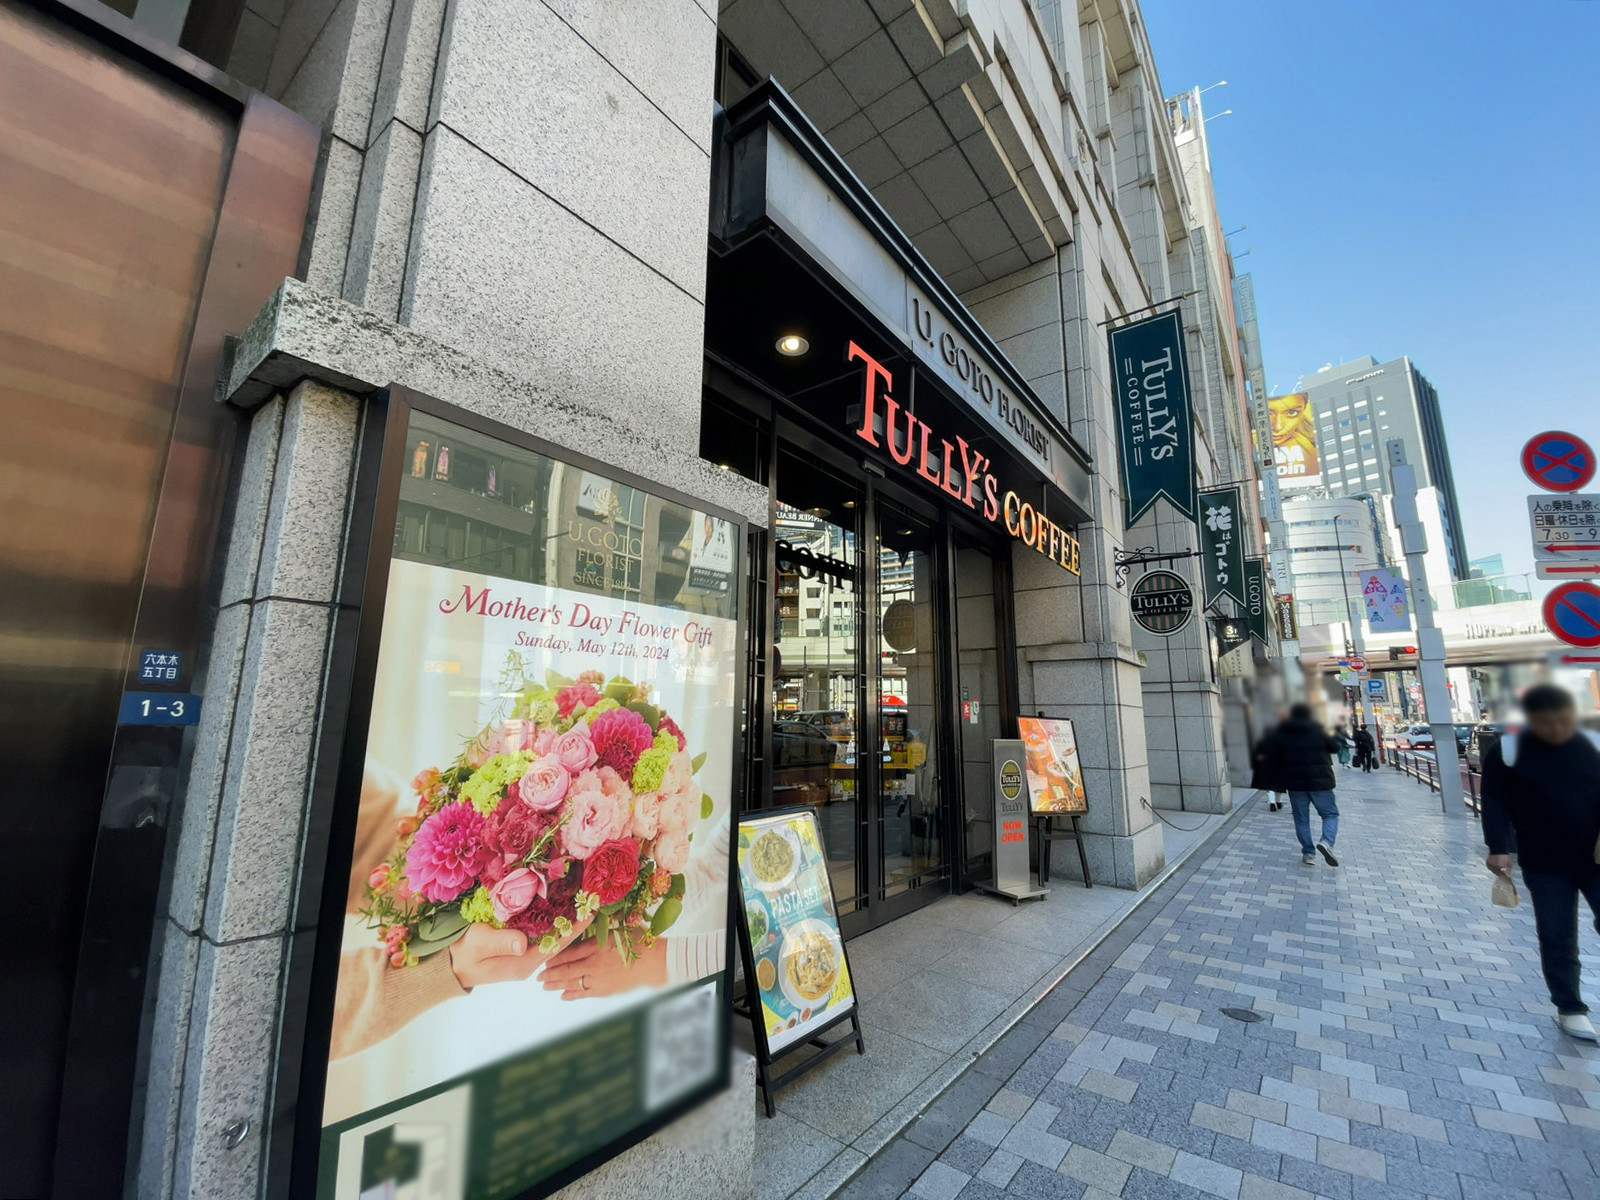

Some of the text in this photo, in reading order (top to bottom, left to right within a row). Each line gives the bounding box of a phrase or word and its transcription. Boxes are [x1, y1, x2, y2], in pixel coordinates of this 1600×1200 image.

[941, 331, 994, 405] GOTO
[996, 388, 1050, 462] FLORIST
[1127, 377, 1145, 445] COFFEE
[1003, 490, 1081, 577] COFFEE
[578, 547, 635, 573] FLORIST
[575, 571, 613, 588] SINCE
[439, 584, 713, 648] Mother's Day Flower Gift
[1144, 606, 1181, 614] COFFEE
[514, 631, 671, 661] Sunday, May 12th, 2024
[144, 653, 179, 666] 六本木
[142, 667, 177, 680] 五丁目
[1367, 680, 1382, 693] P
[1002, 820, 1023, 832] NOW
[1001, 831, 1024, 843] OPEN
[769, 891, 803, 920] PASTA
[803, 885, 821, 907] SET
